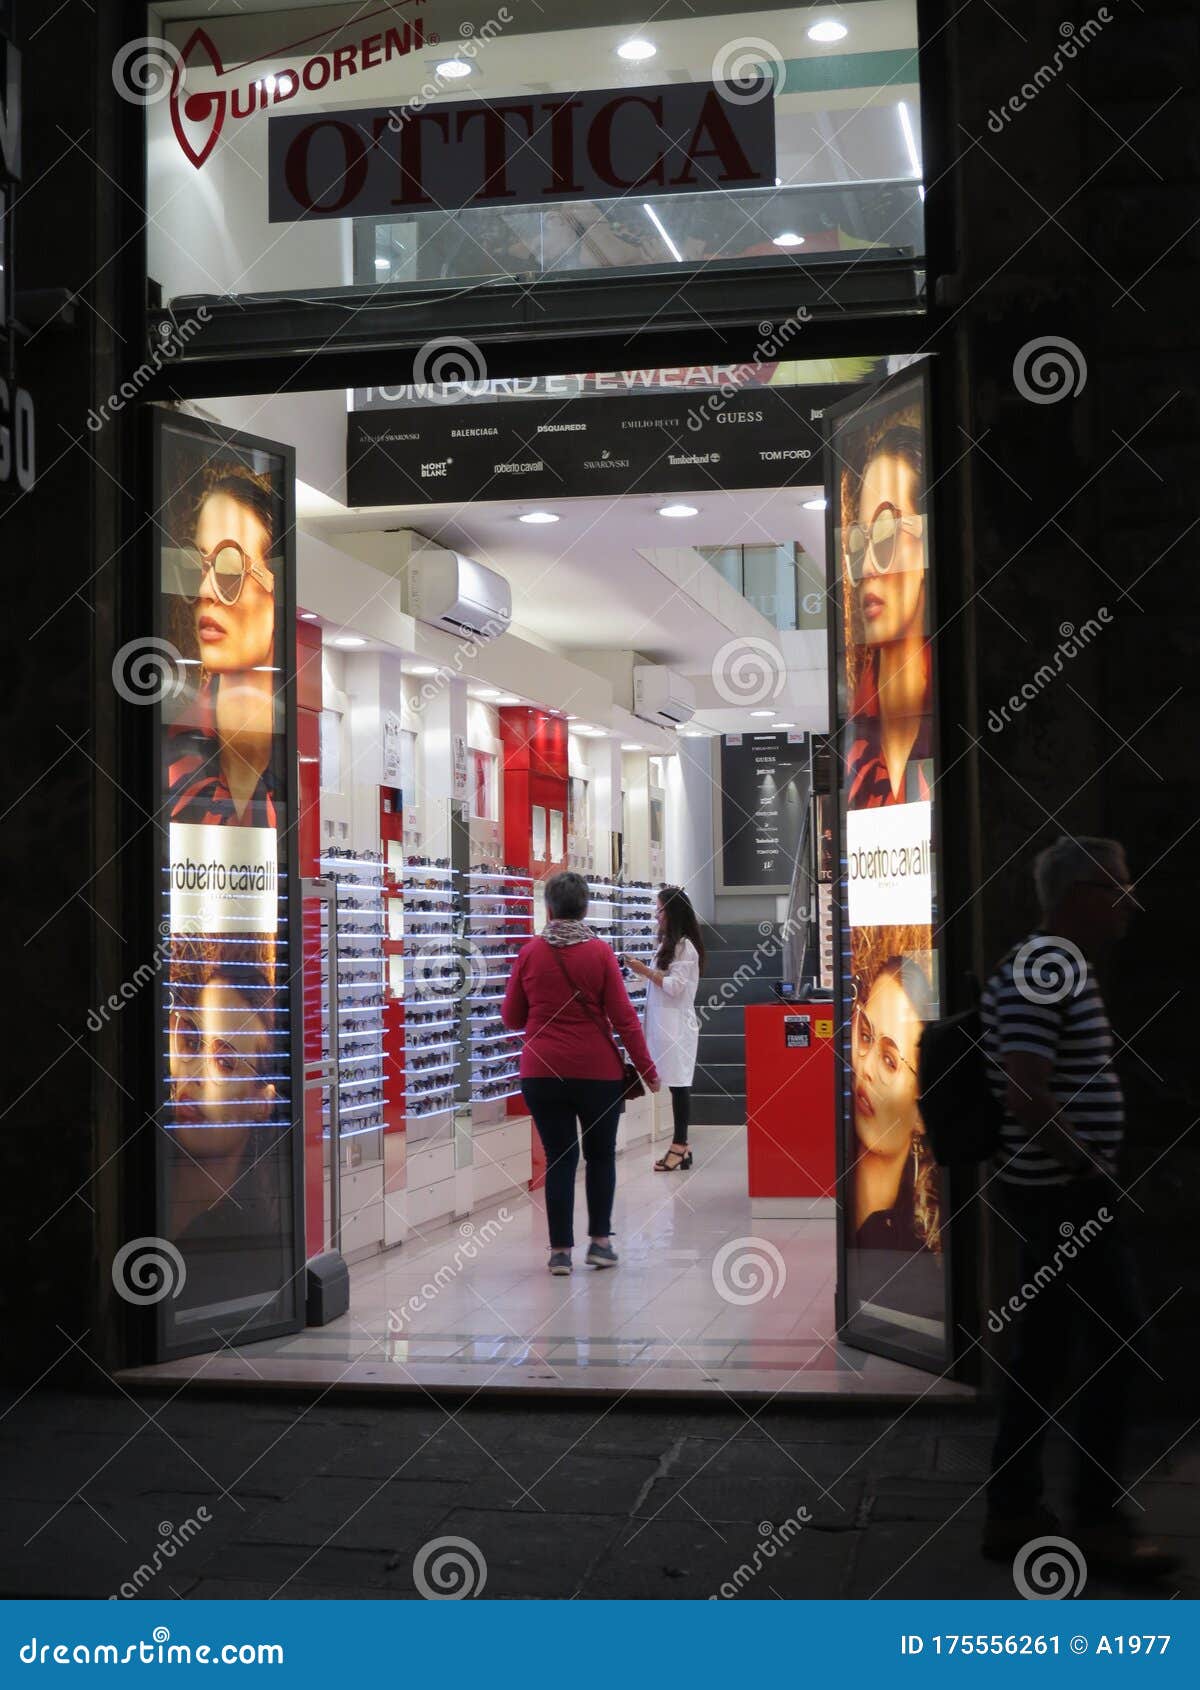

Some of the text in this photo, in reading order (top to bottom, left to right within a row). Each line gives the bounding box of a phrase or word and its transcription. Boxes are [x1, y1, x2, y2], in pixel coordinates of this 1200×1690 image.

[284, 89, 761, 214] OTTICA
[716, 411, 763, 424] GUESS
[451, 428, 499, 438] BALENCIAGA
[537, 423, 587, 433] DSQUARED2
[667, 453, 709, 465] Timberland
[760, 449, 811, 461] TOM FORD
[421, 462, 447, 470] MONT
[494, 461, 544, 474] roberto cavalli
[584, 459, 630, 470] SWAROVSKI
[421, 469, 447, 478] BLANC
[849, 846, 888, 880] oberto
[171, 858, 226, 890] roberto
